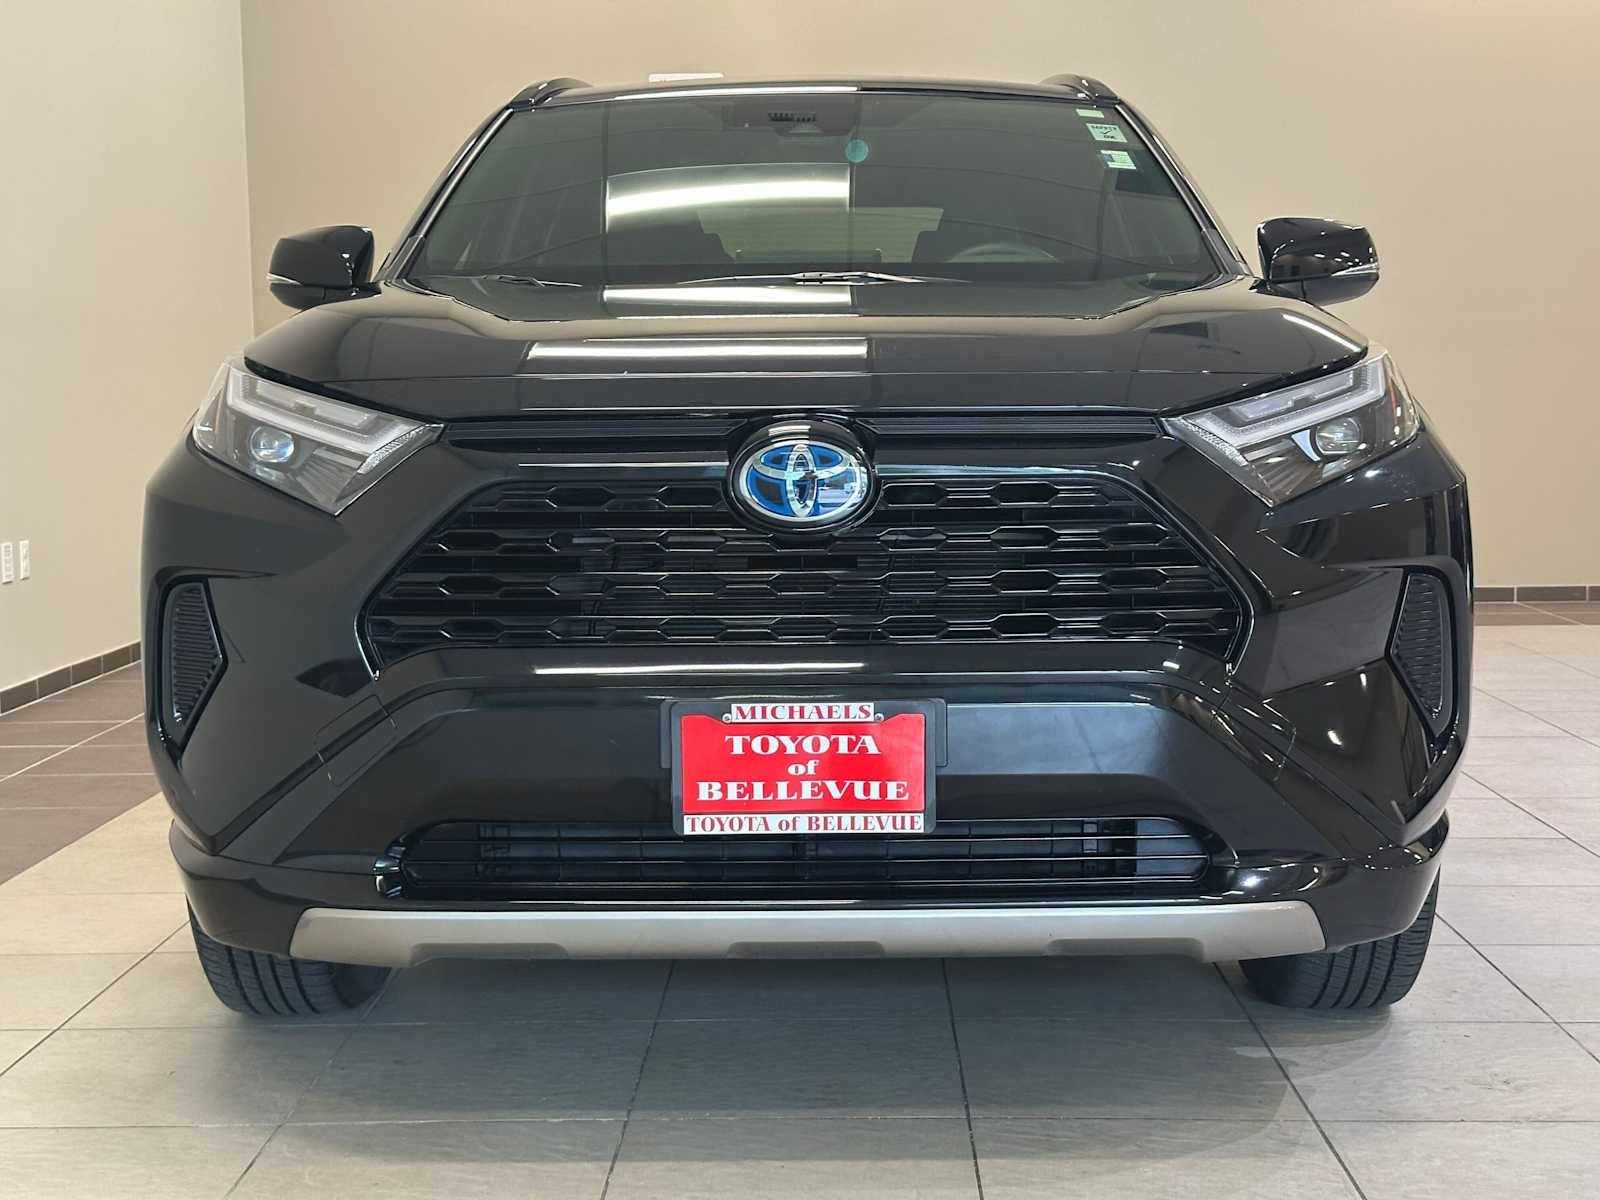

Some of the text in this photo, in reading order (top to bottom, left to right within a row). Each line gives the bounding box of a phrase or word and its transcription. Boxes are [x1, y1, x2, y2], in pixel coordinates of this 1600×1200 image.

[735, 704, 871, 721] MICHAELS
[725, 735, 881, 755] TOYOTA
[787, 759, 819, 776] of
[696, 780, 910, 801] BELLEVUE
[686, 815, 922, 833] TOYOTA of BELLEVUE
